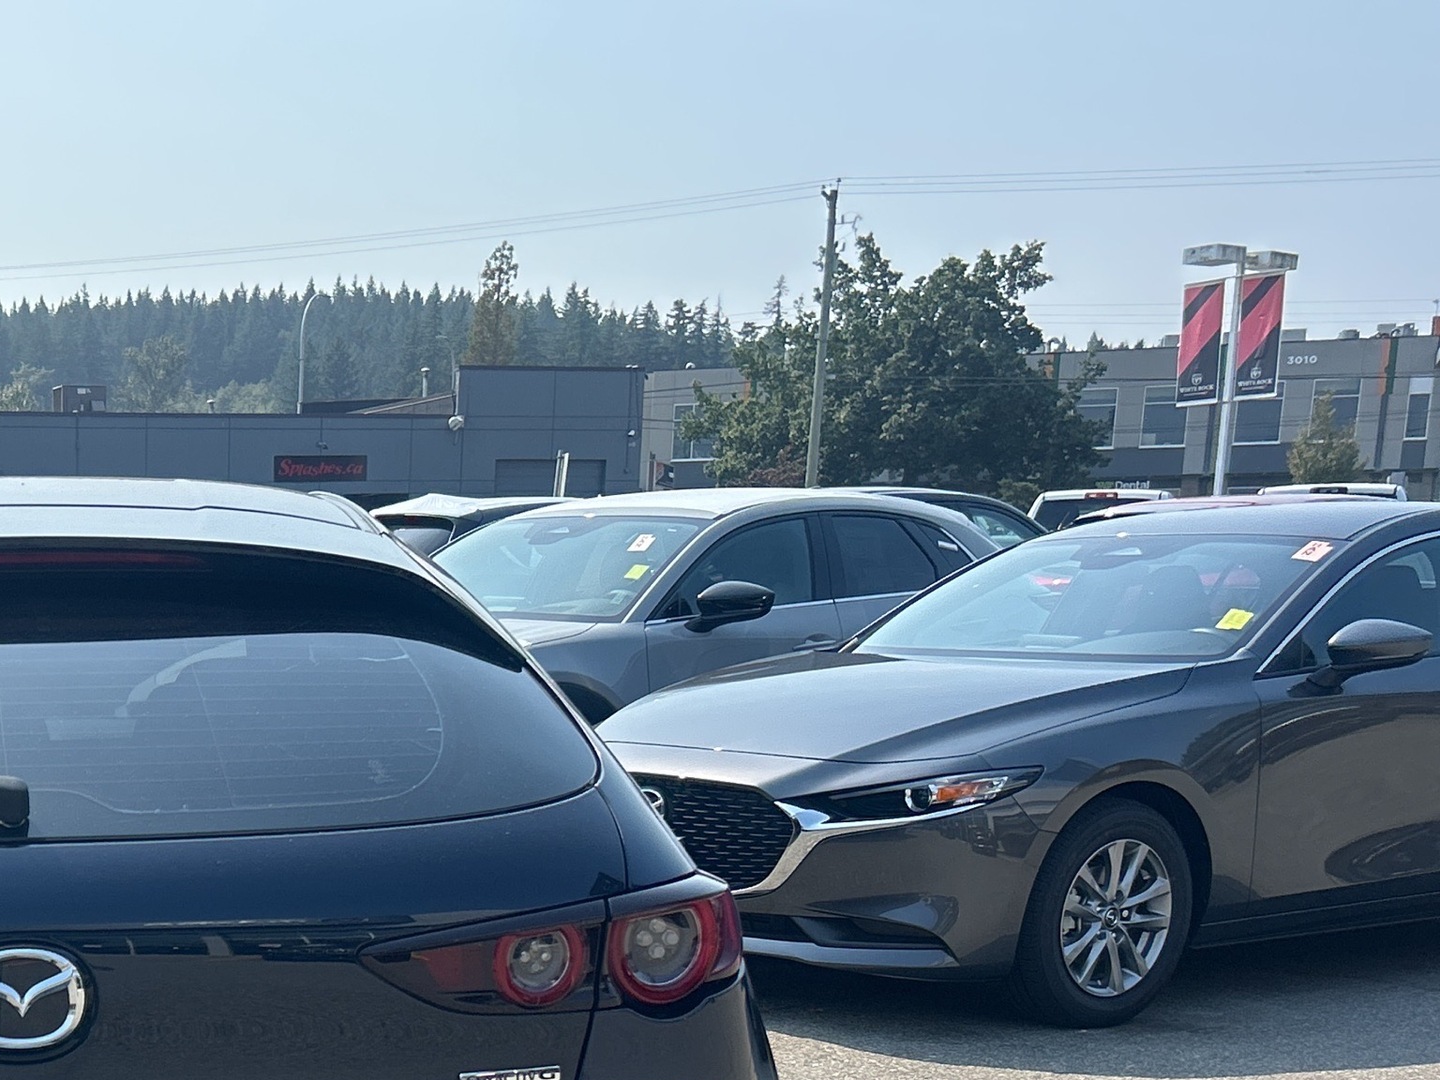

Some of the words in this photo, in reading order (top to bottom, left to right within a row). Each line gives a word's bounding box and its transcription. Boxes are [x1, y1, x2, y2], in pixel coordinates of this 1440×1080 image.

[1287, 355, 1317, 365] 3010
[278, 458, 363, 477] Splashes.ca
[1115, 480, 1150, 489] Dental
